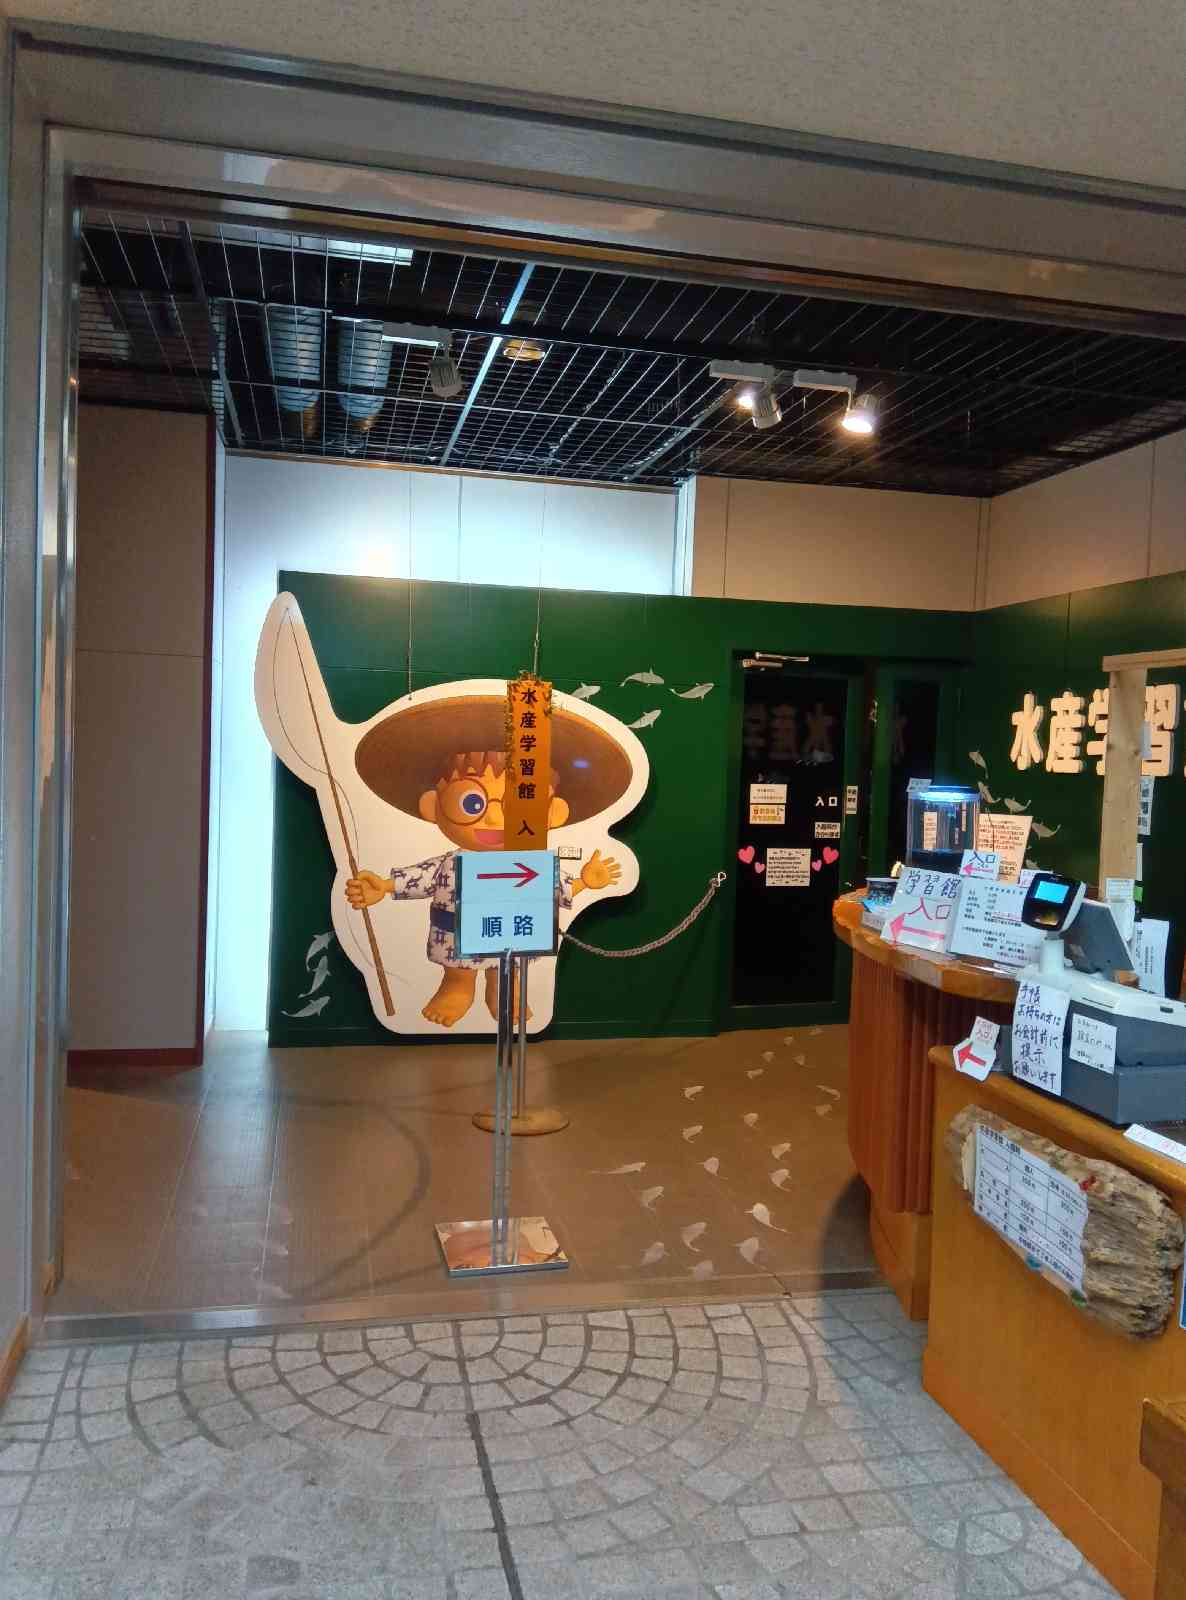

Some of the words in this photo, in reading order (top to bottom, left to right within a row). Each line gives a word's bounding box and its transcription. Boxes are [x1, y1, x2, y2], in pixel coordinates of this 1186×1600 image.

[1010, 682, 1186, 776] 水産学習
[517, 687, 538, 800] 水産学習館
[815, 796, 838, 807] 入口
[968, 850, 996, 864] 入口
[904, 869, 961, 900] 学習館
[903, 896, 952, 921] 入口
[481, 915, 534, 938] 順路
